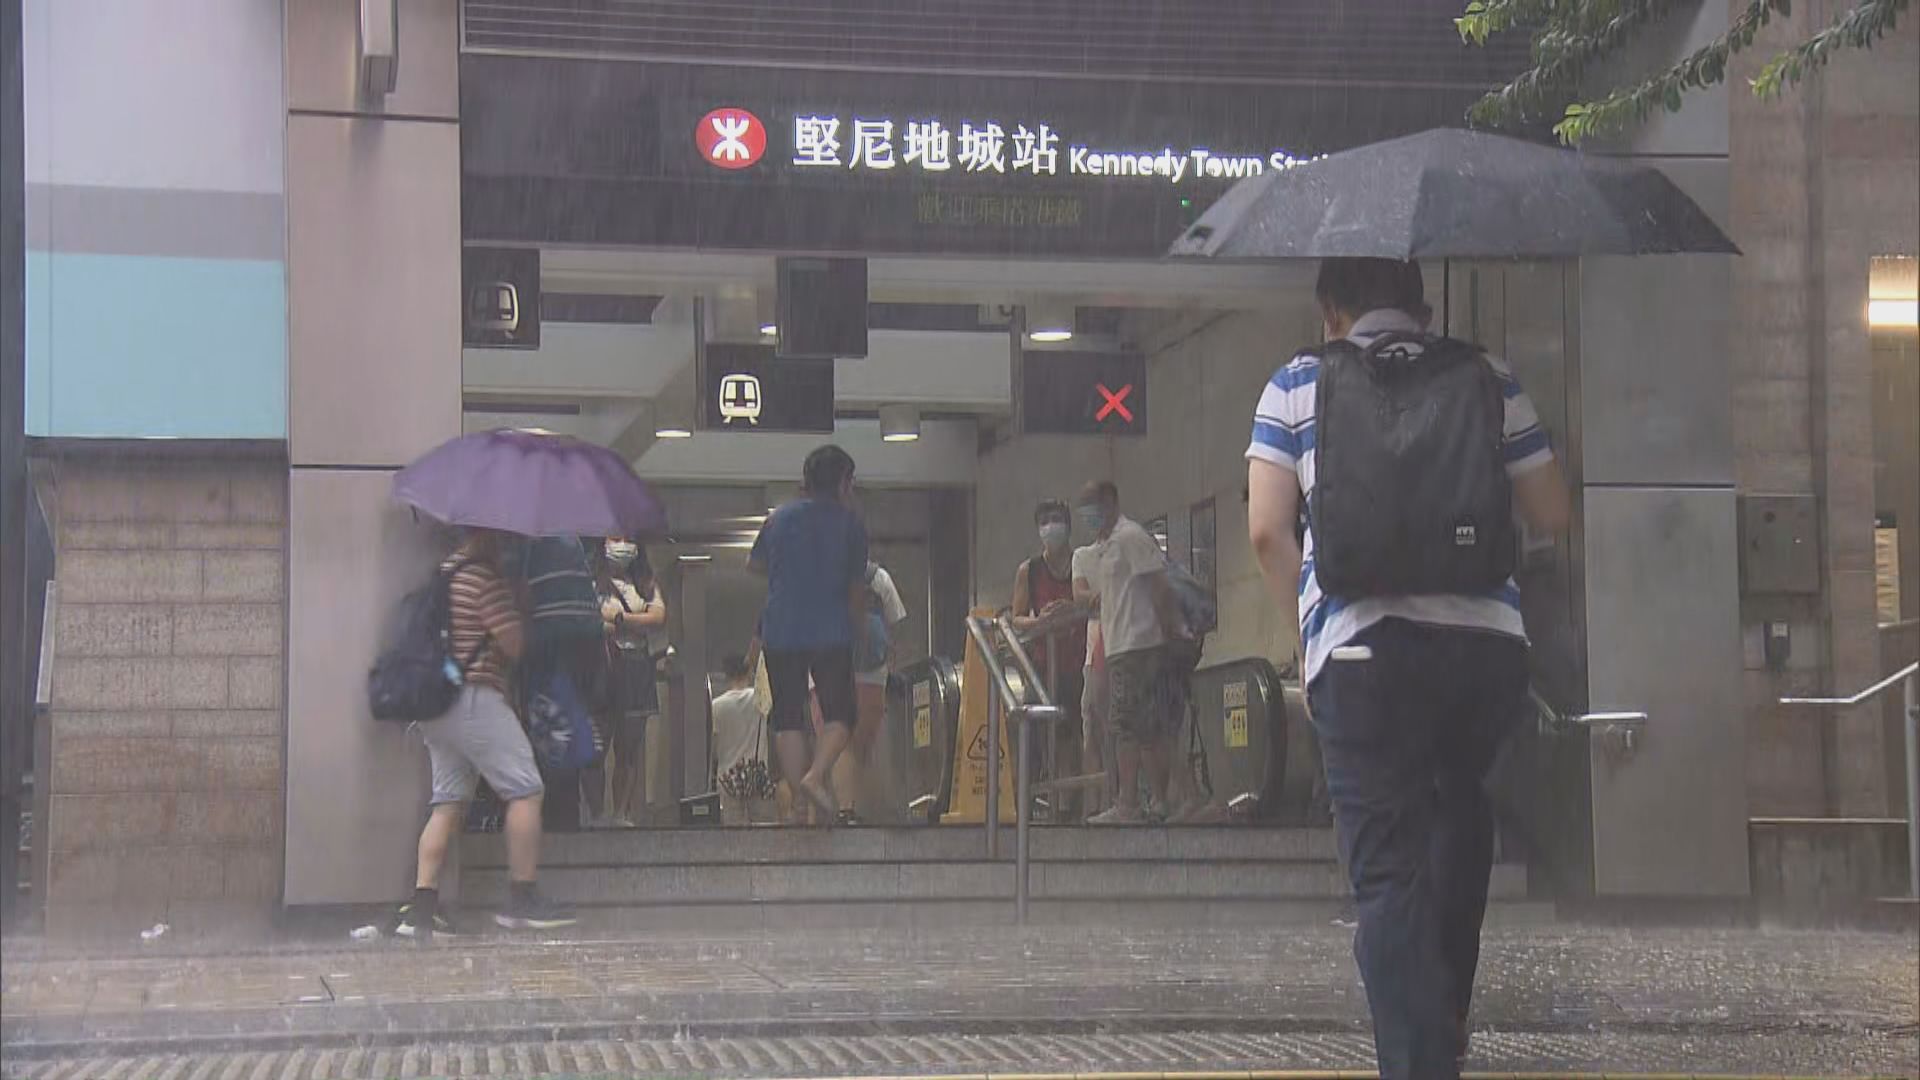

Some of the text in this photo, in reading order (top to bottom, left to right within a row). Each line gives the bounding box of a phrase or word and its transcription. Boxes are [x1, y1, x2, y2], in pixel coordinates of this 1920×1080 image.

[793, 116, 1059, 175] 堅尼地城站
[1069, 147, 1188, 183] Kennedy
[1190, 150, 1263, 177] Town
